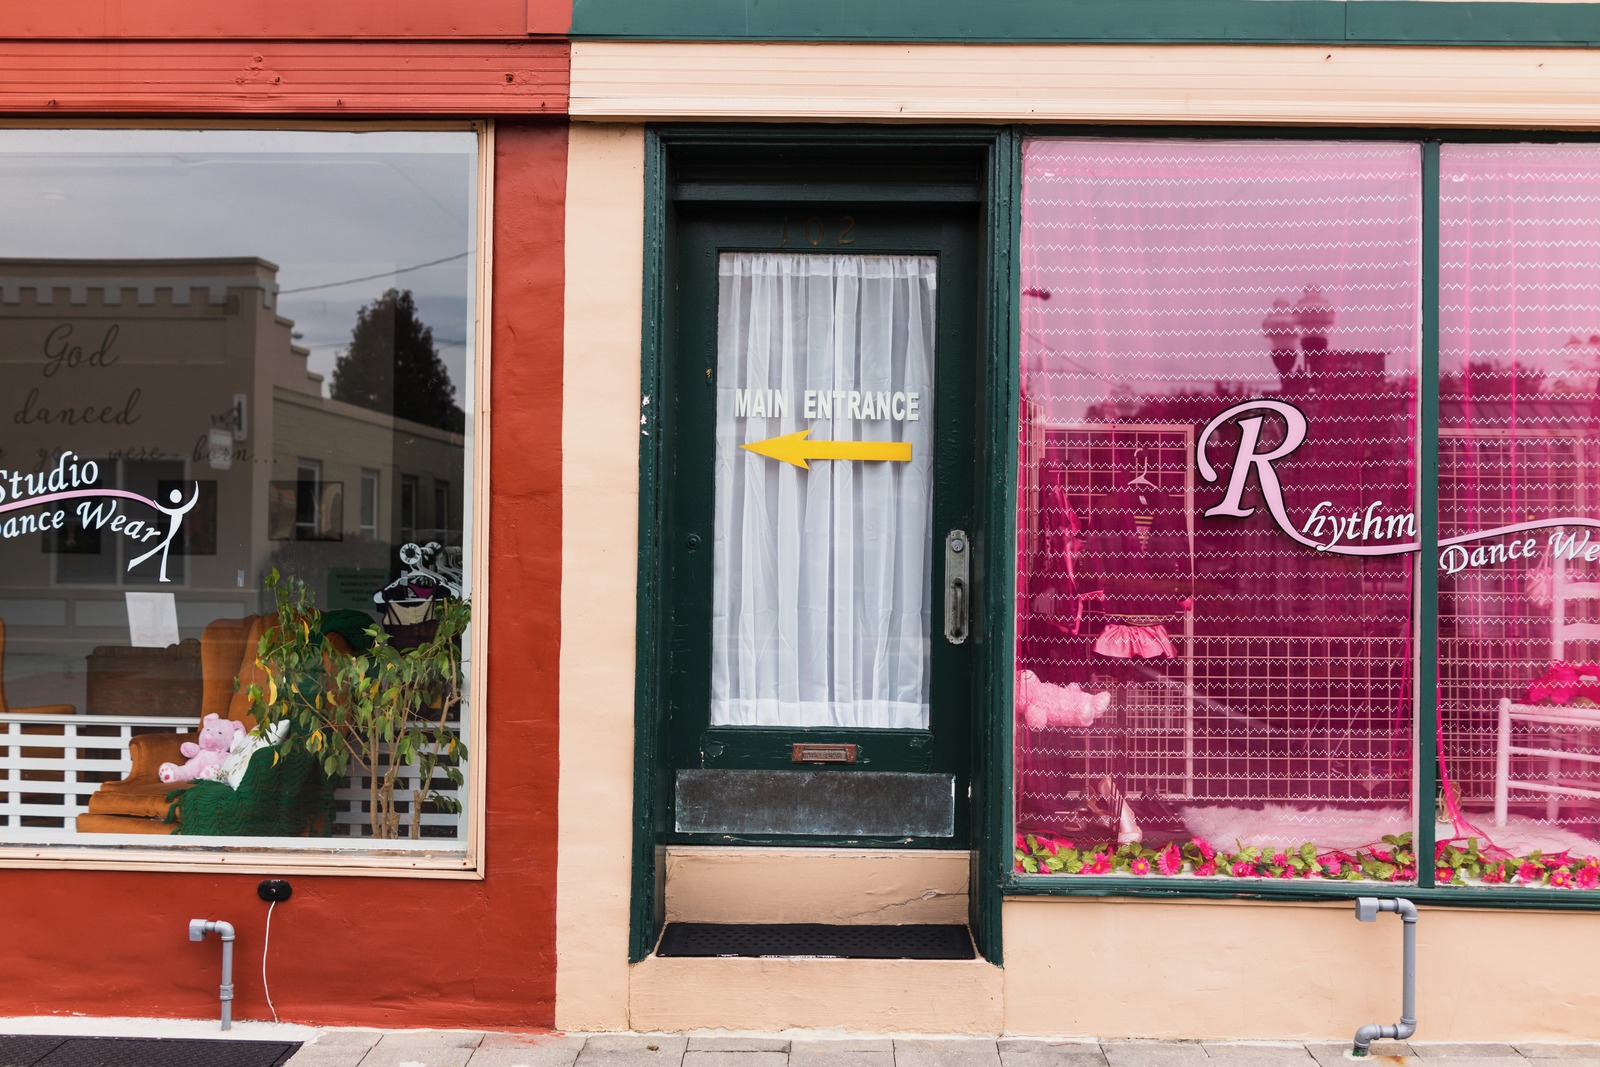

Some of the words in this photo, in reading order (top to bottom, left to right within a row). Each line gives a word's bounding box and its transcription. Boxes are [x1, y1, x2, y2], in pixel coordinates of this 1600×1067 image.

[781, 215, 856, 248] 102
[42, 323, 120, 378] God
[13, 387, 142, 425] danced
[734, 388, 789, 418] MAIN
[803, 389, 919, 421] ENTRANCE
[0, 508, 65, 539] ance
[76, 499, 162, 543] Wear
[1439, 536, 1537, 575] Dance
